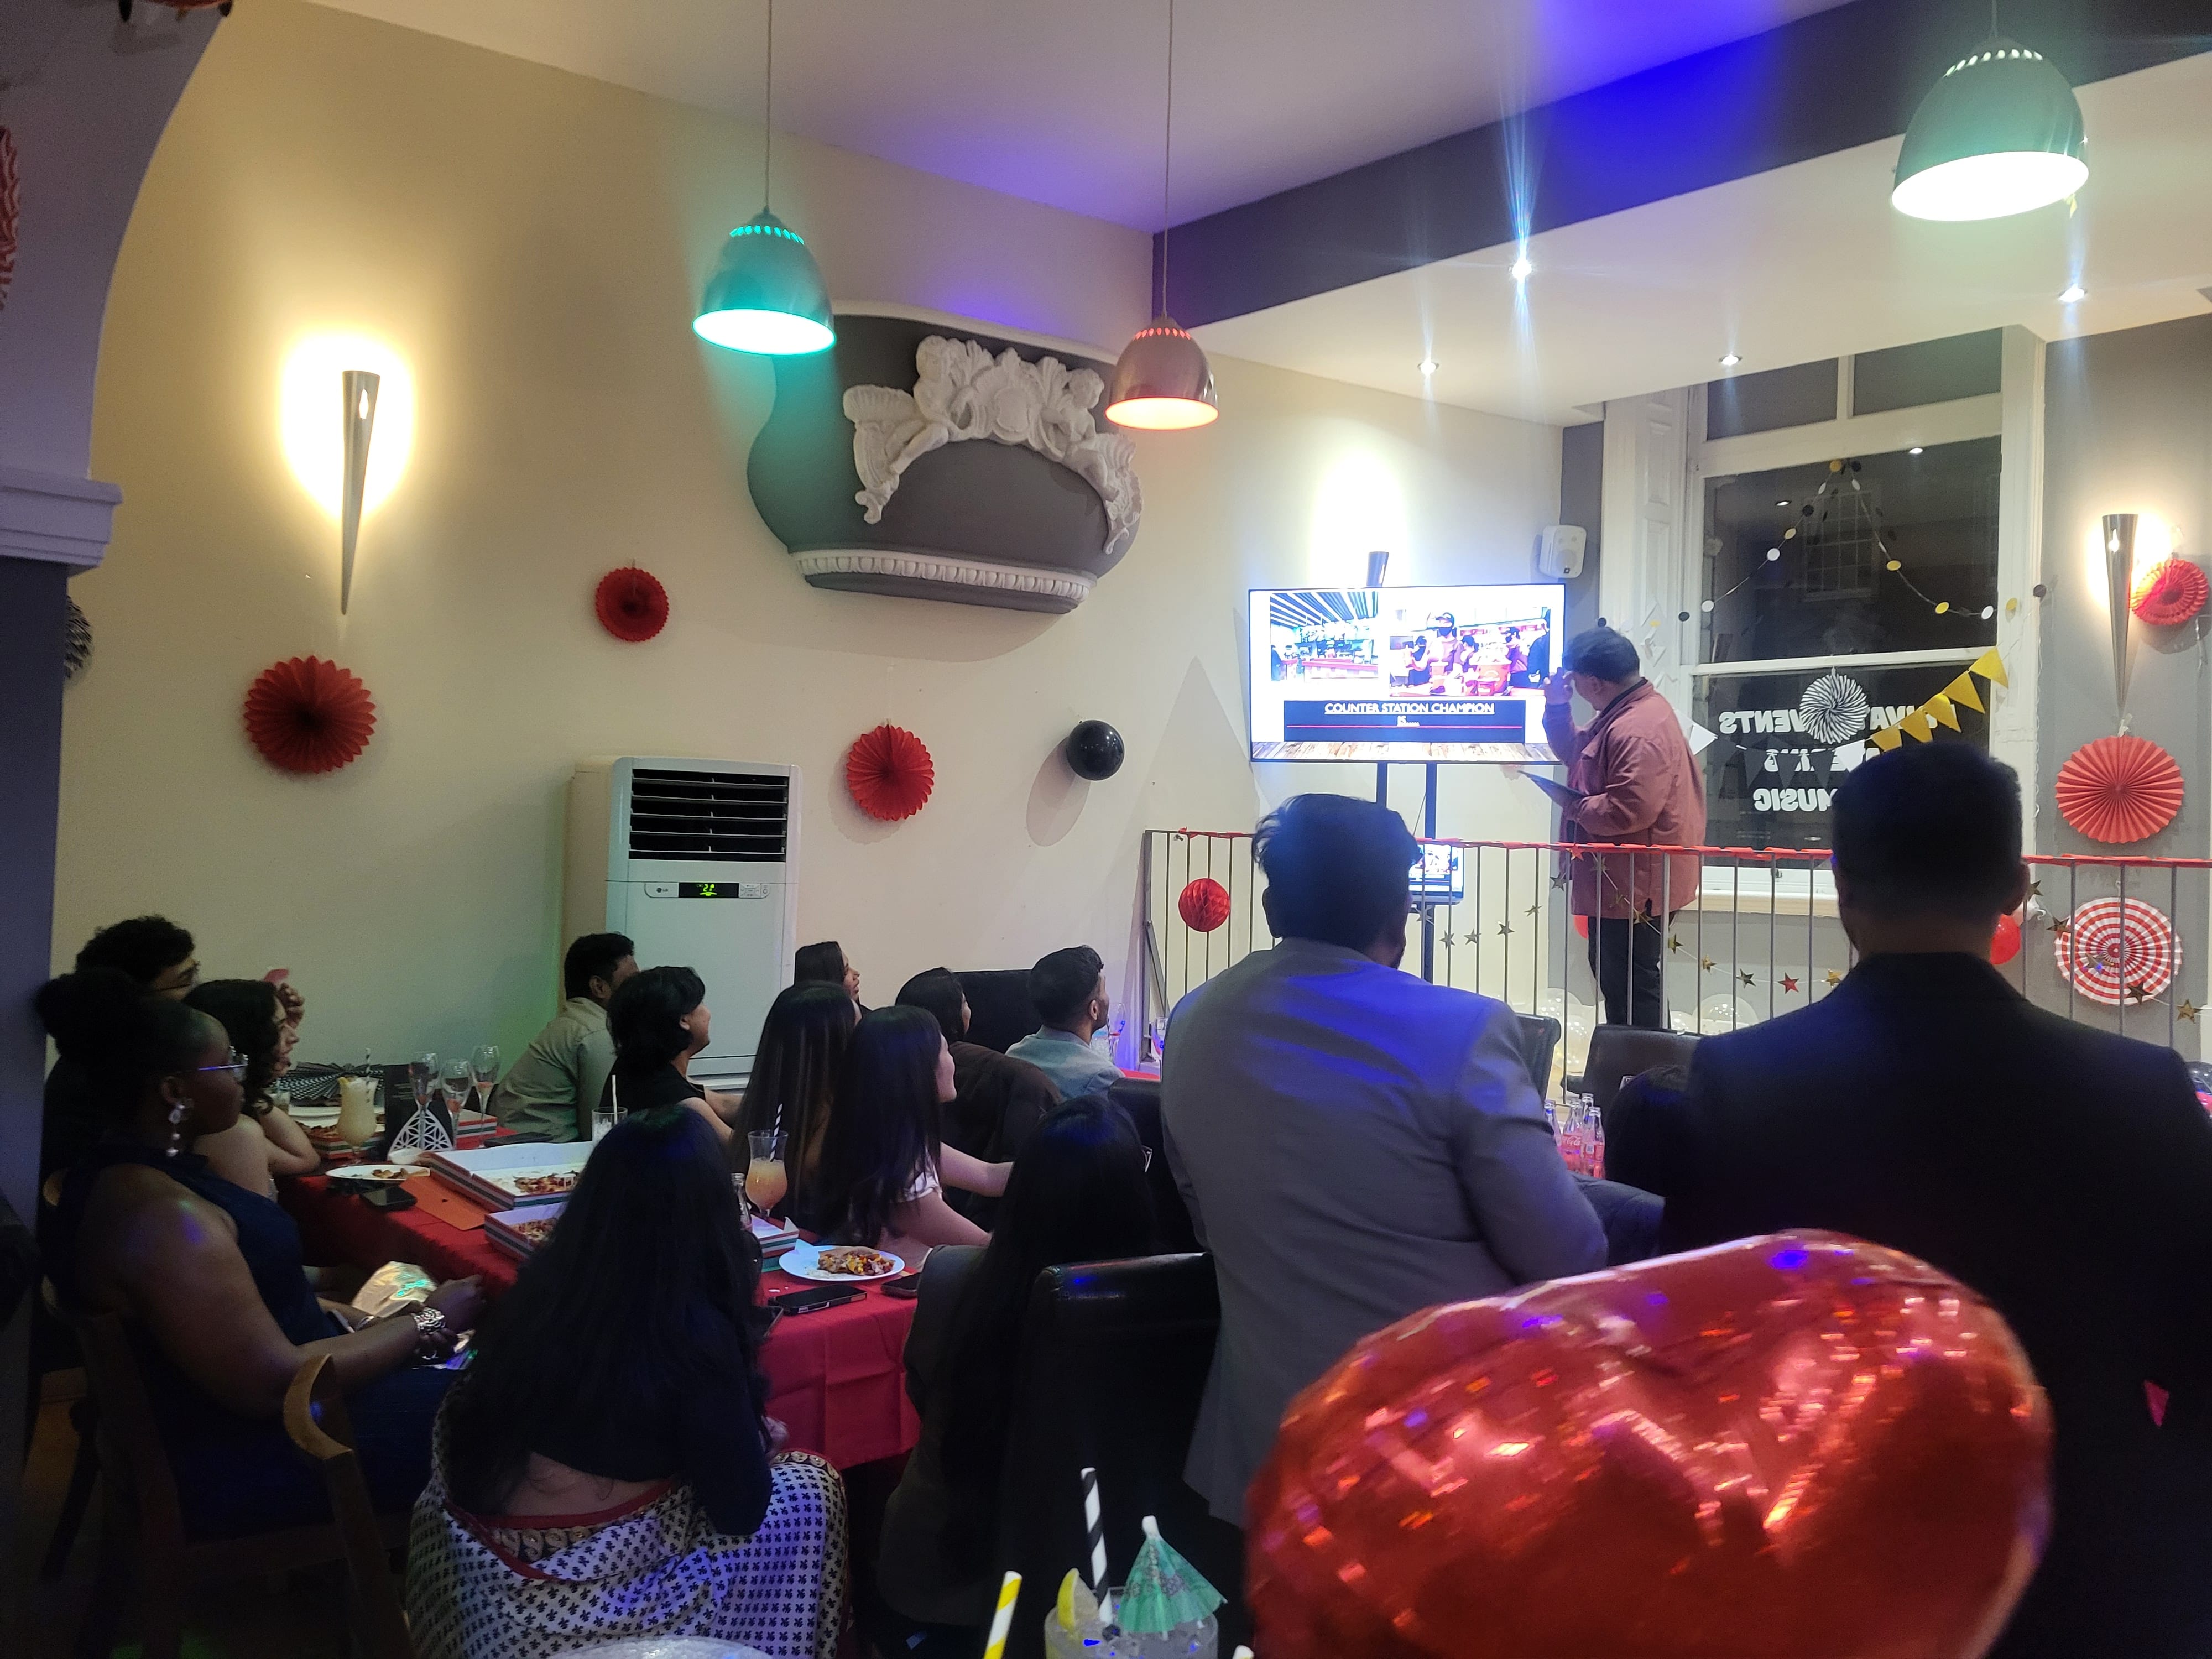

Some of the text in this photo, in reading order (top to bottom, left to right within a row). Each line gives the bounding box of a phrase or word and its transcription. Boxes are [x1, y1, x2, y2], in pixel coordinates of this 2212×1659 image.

[1324, 703, 1495, 713] COUNTER STATION CHAMPION
